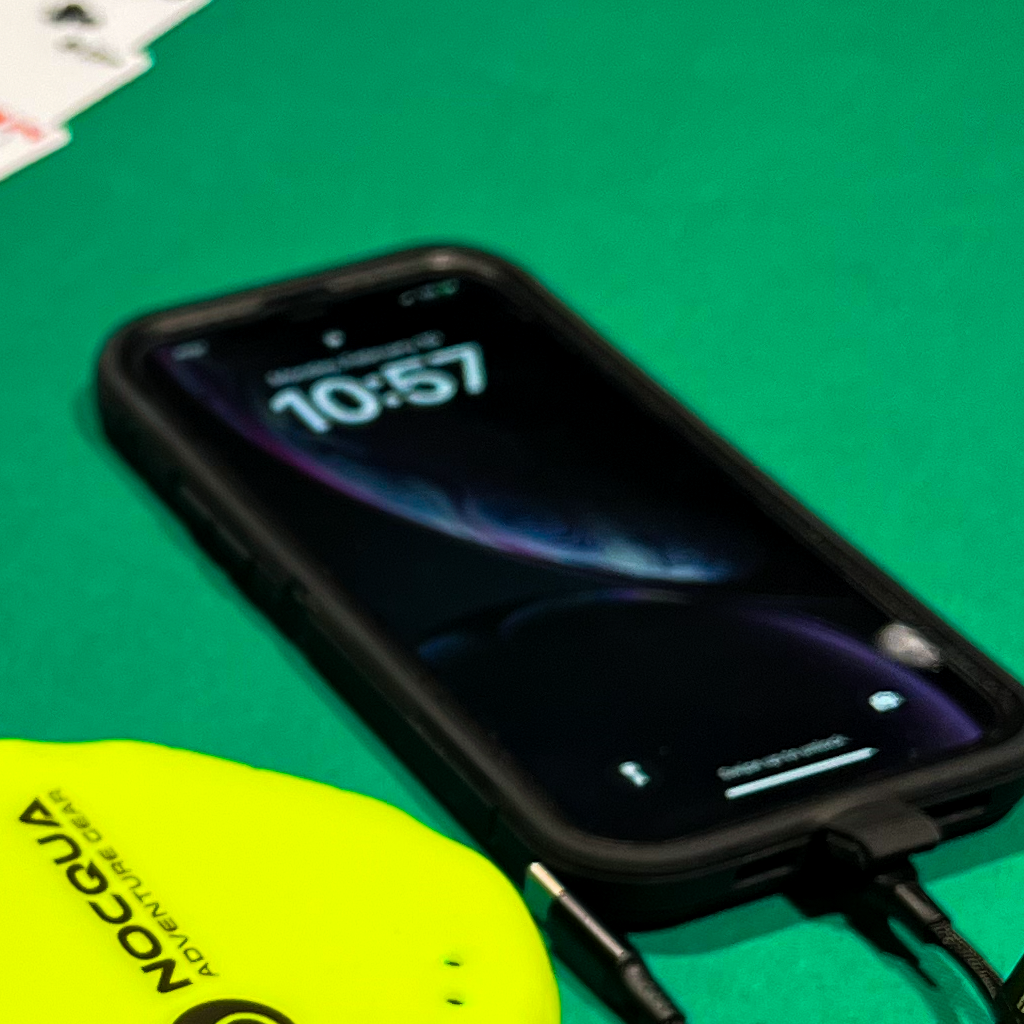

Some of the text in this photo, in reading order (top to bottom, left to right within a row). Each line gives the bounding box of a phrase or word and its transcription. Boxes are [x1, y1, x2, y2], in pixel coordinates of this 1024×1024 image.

[269, 341, 487, 434] 10:57
[18, 797, 193, 994] NOCQUA
[47, 787, 219, 978] ADVENTURE GEAR
